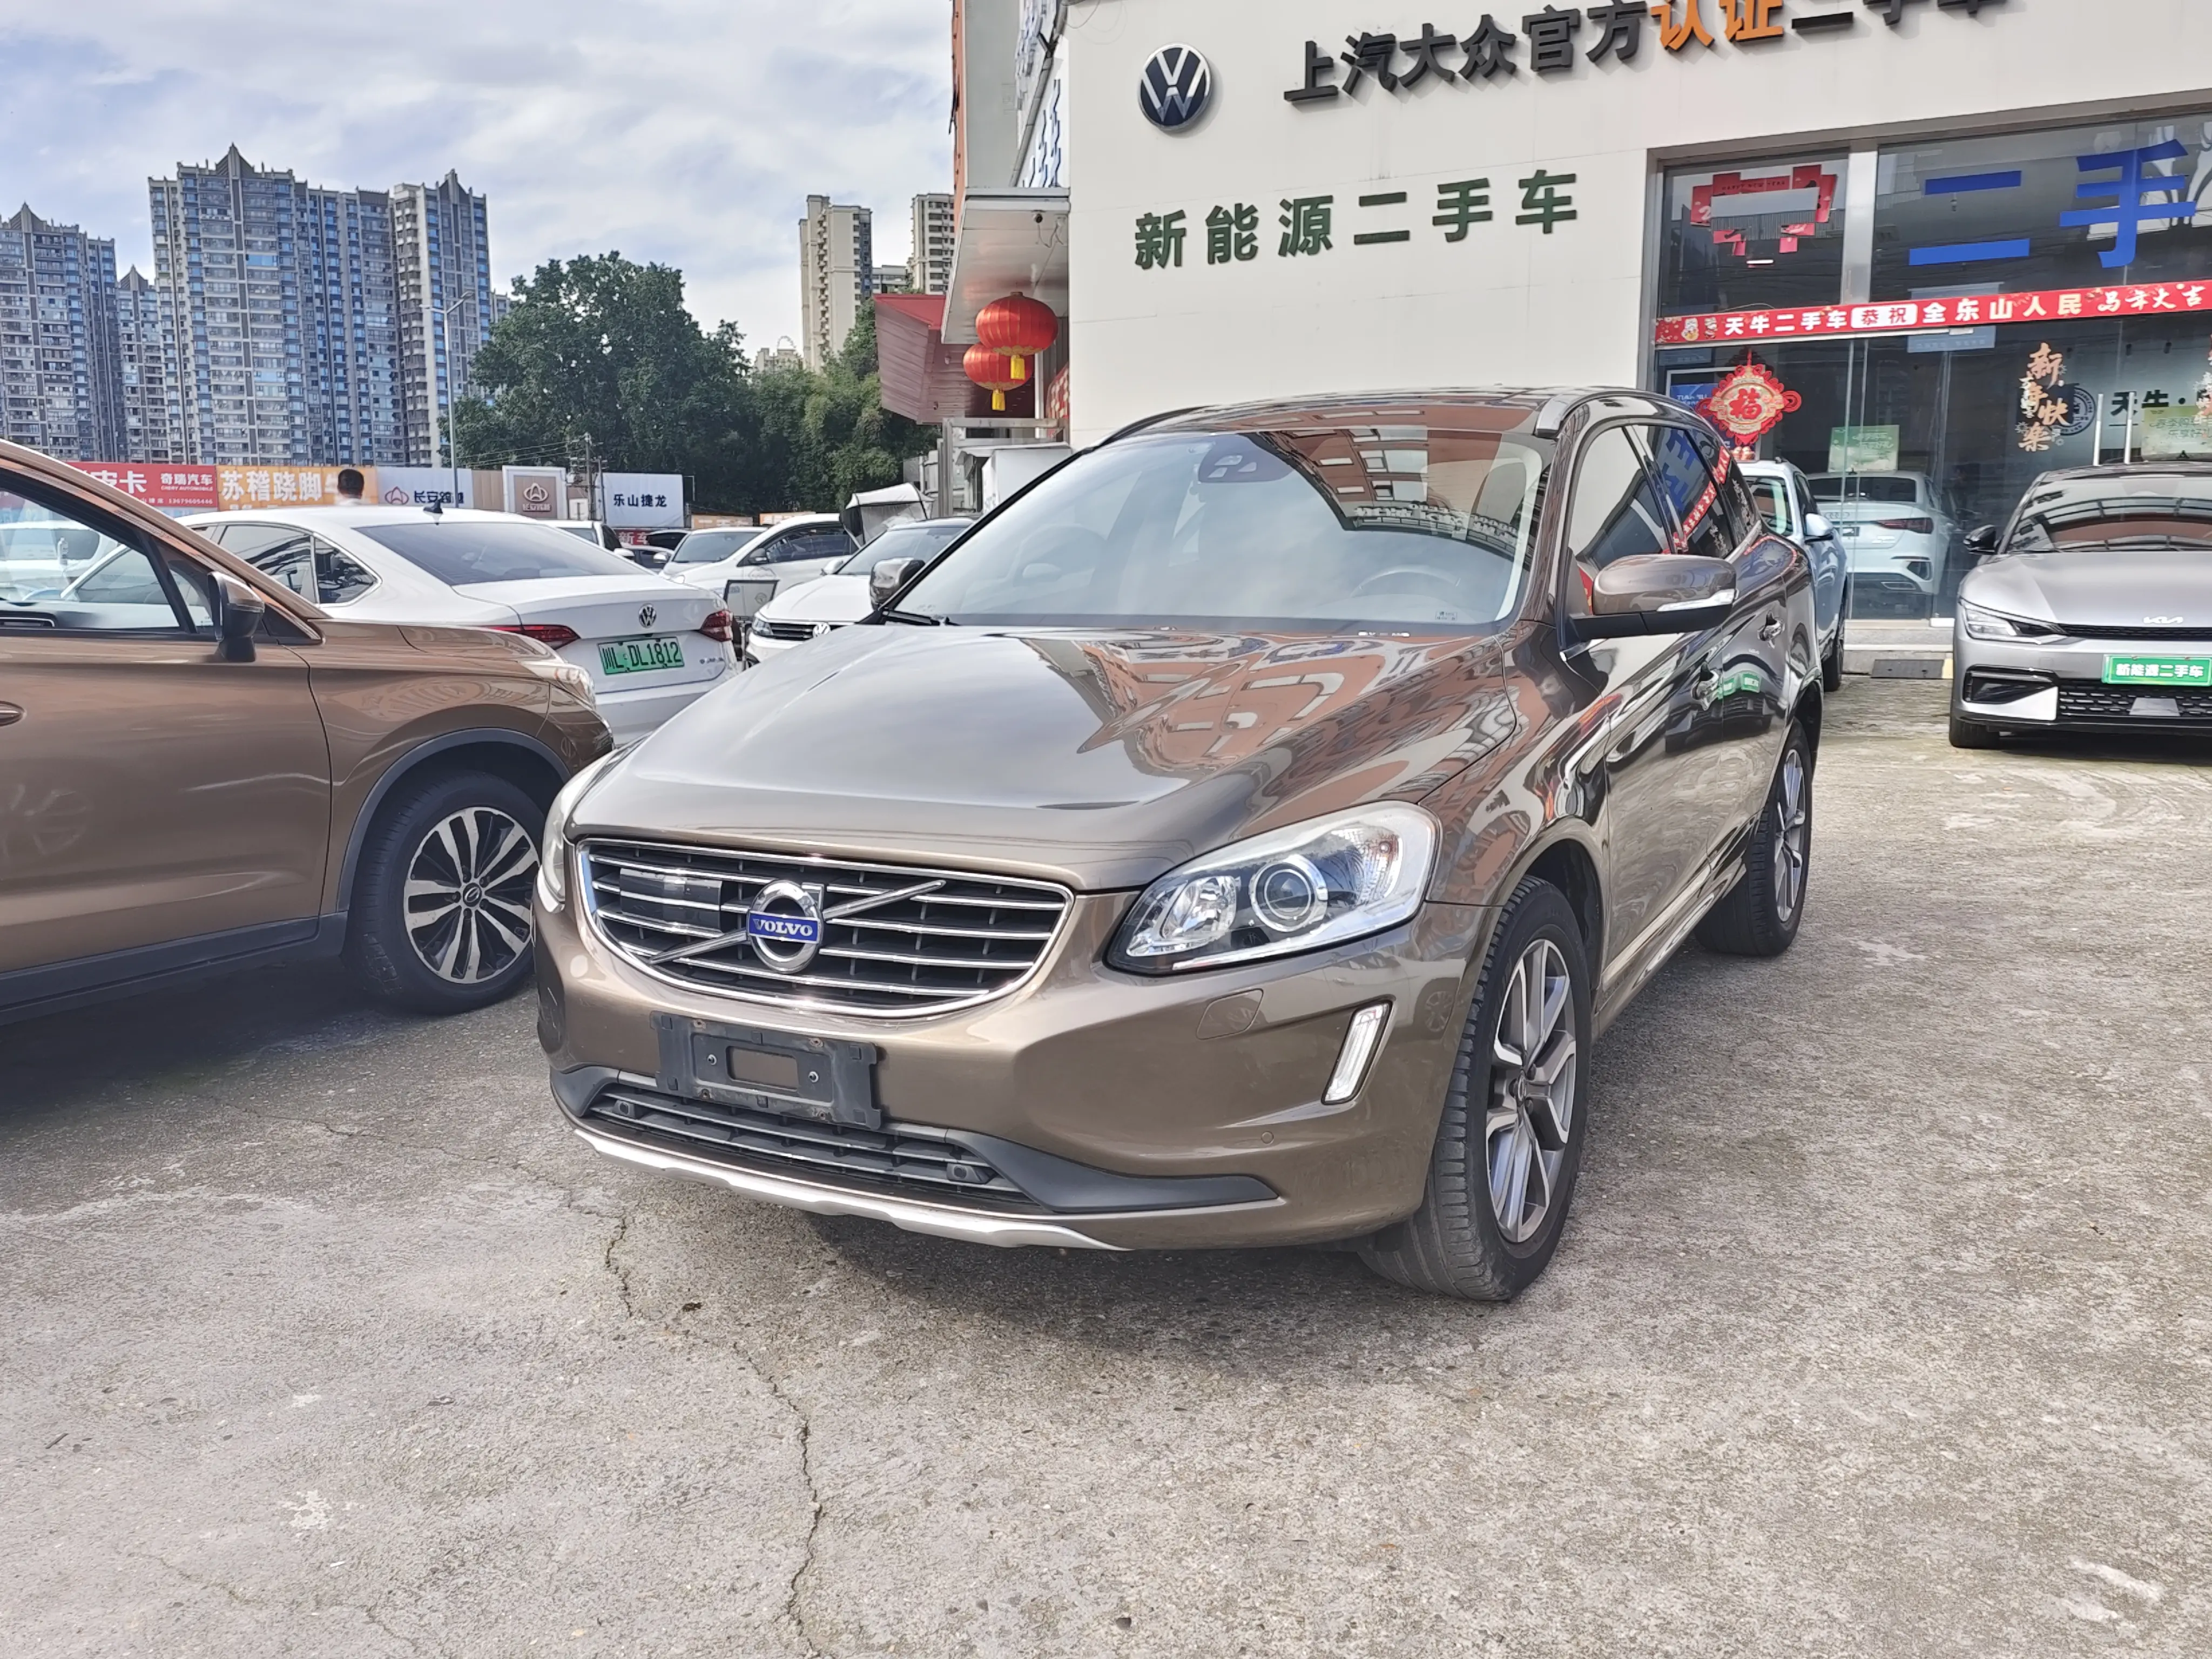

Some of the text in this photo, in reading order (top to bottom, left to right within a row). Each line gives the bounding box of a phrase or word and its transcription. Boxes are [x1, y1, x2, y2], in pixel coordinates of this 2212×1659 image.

[1284, 0, 1978, 105] 上汽大众官方认证
[1135, 170, 1577, 269] 新能源二手车
[1729, 388, 1762, 420] 福
[160, 473, 213, 485] 奇瑞汽车
[613, 494, 667, 507] 乐山捷龙
[2116, 663, 2204, 678] 新能源二手车
[753, 919, 813, 936] VOLVO
